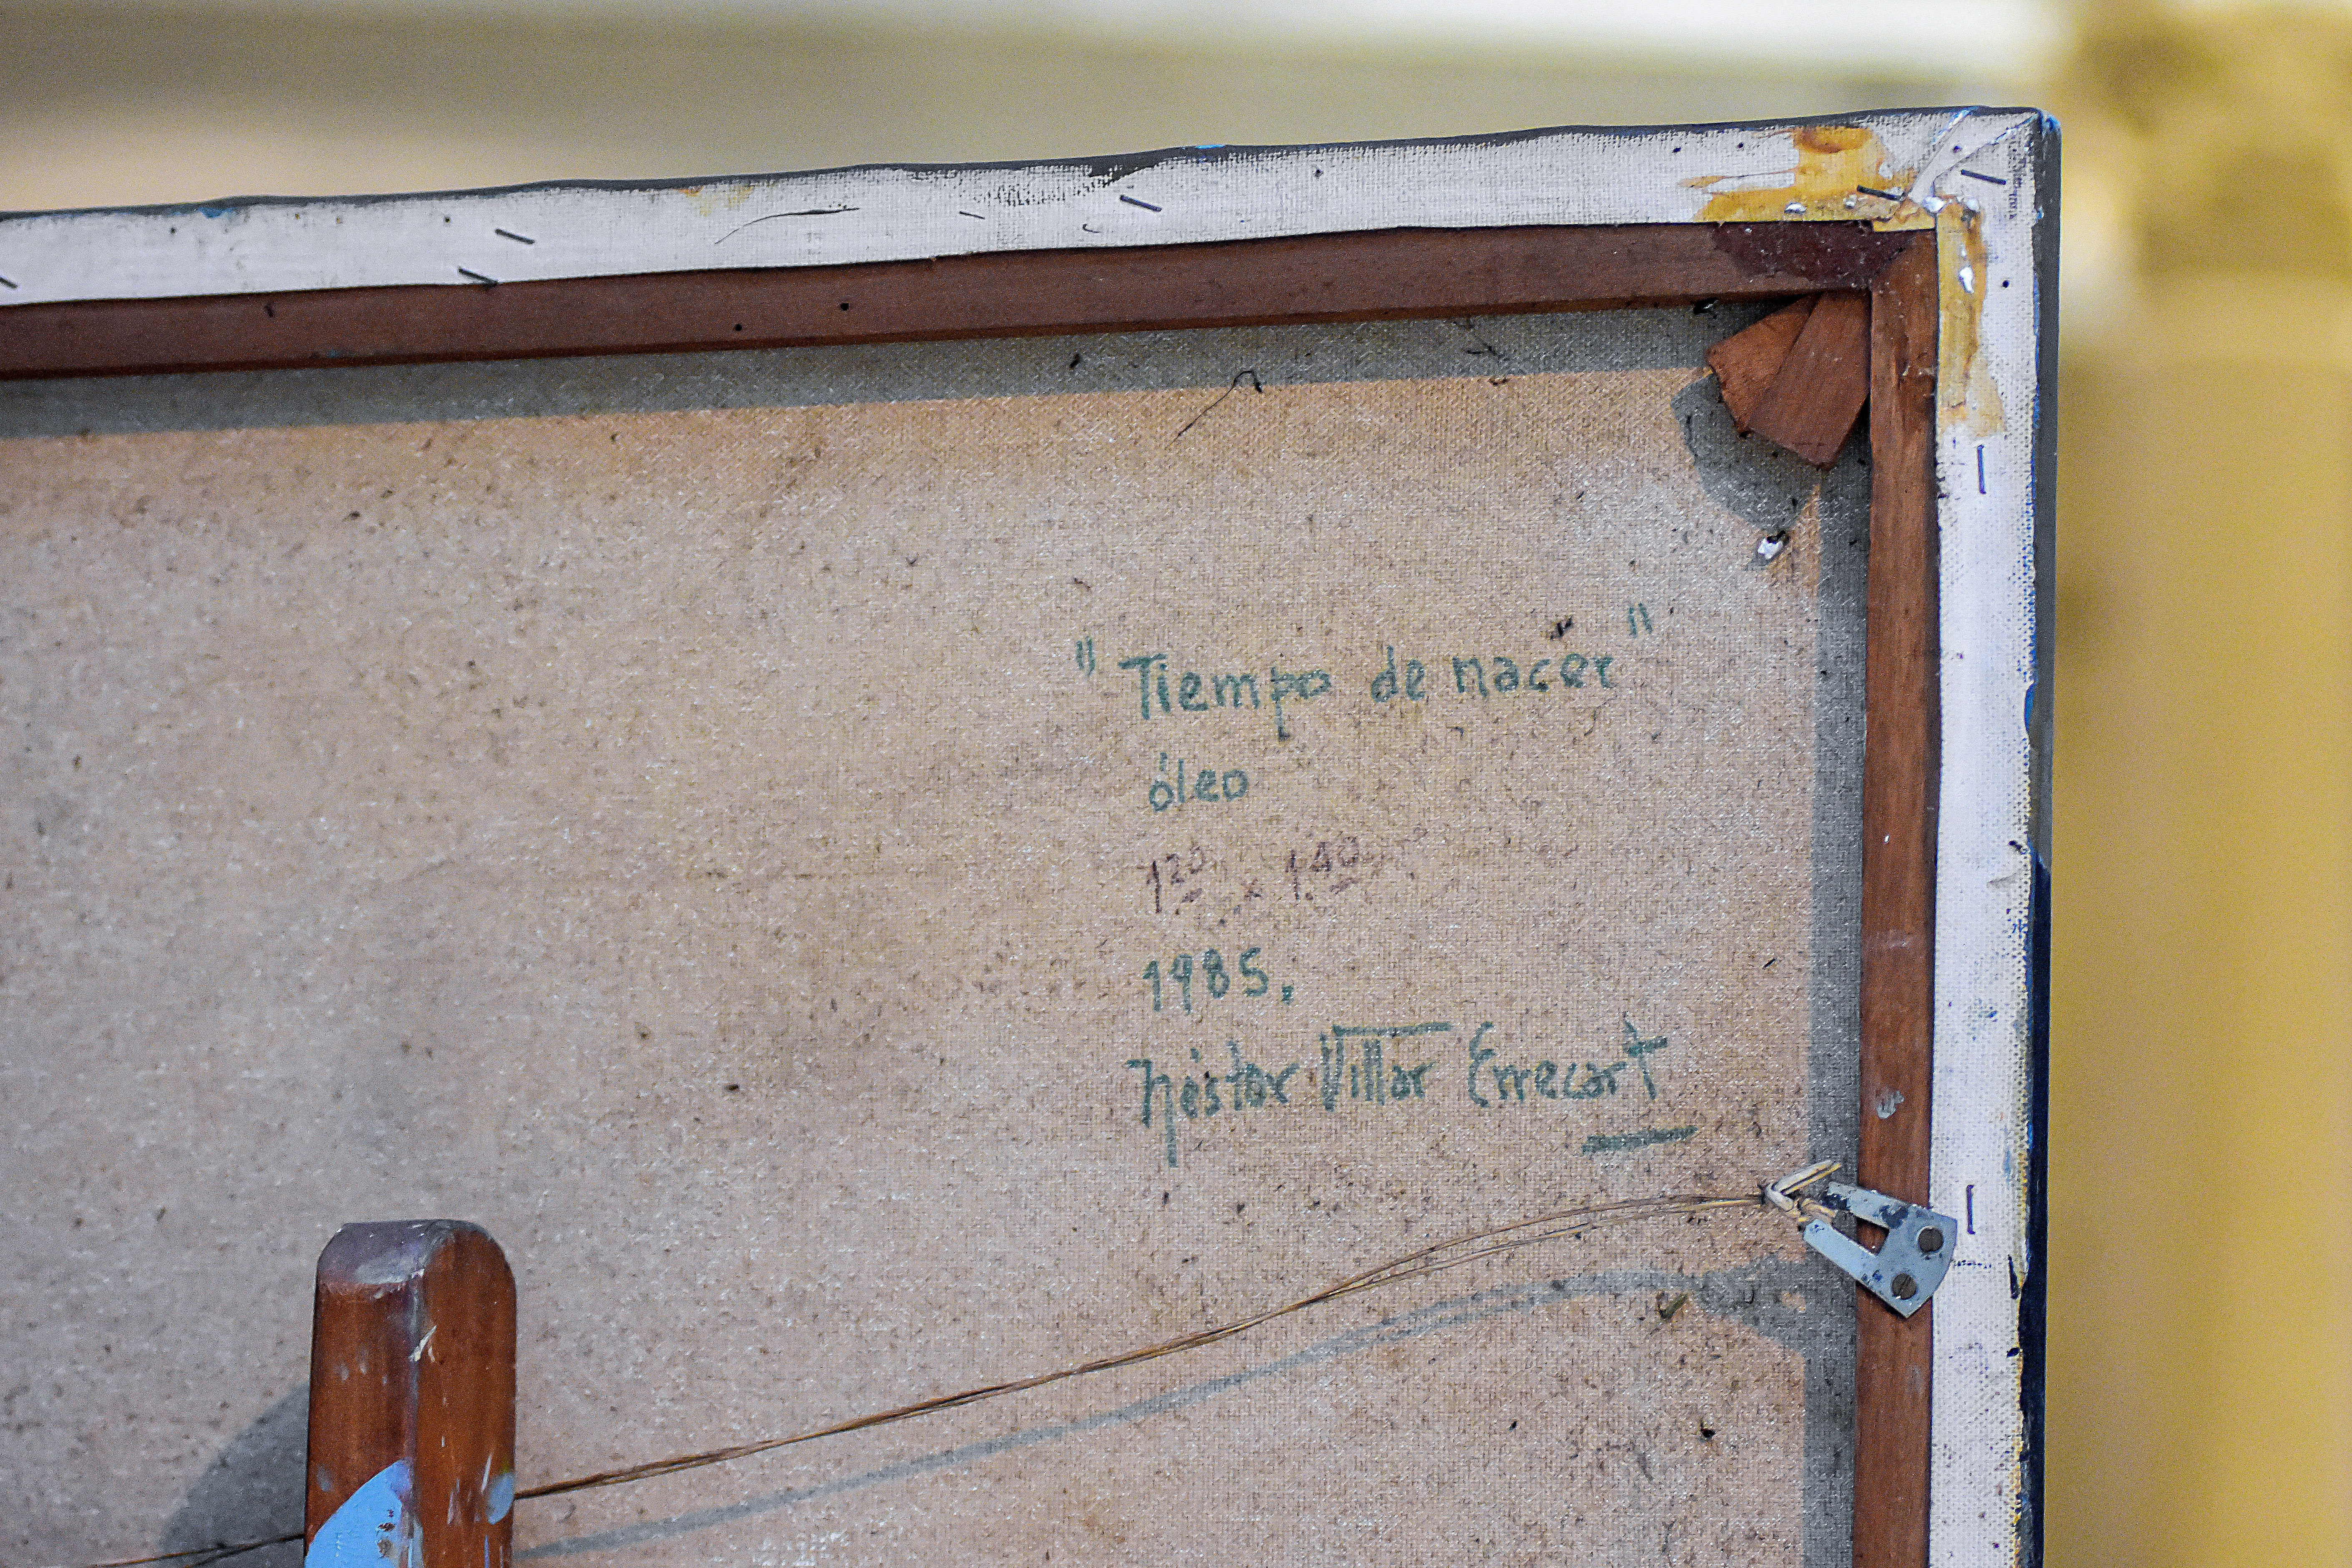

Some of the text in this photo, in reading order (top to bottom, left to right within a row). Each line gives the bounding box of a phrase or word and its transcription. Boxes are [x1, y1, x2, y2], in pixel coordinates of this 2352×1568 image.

[1370, 645, 1426, 703] de
[1149, 752, 1249, 813] óleo
[1321, 1022, 1452, 1111] Villar
